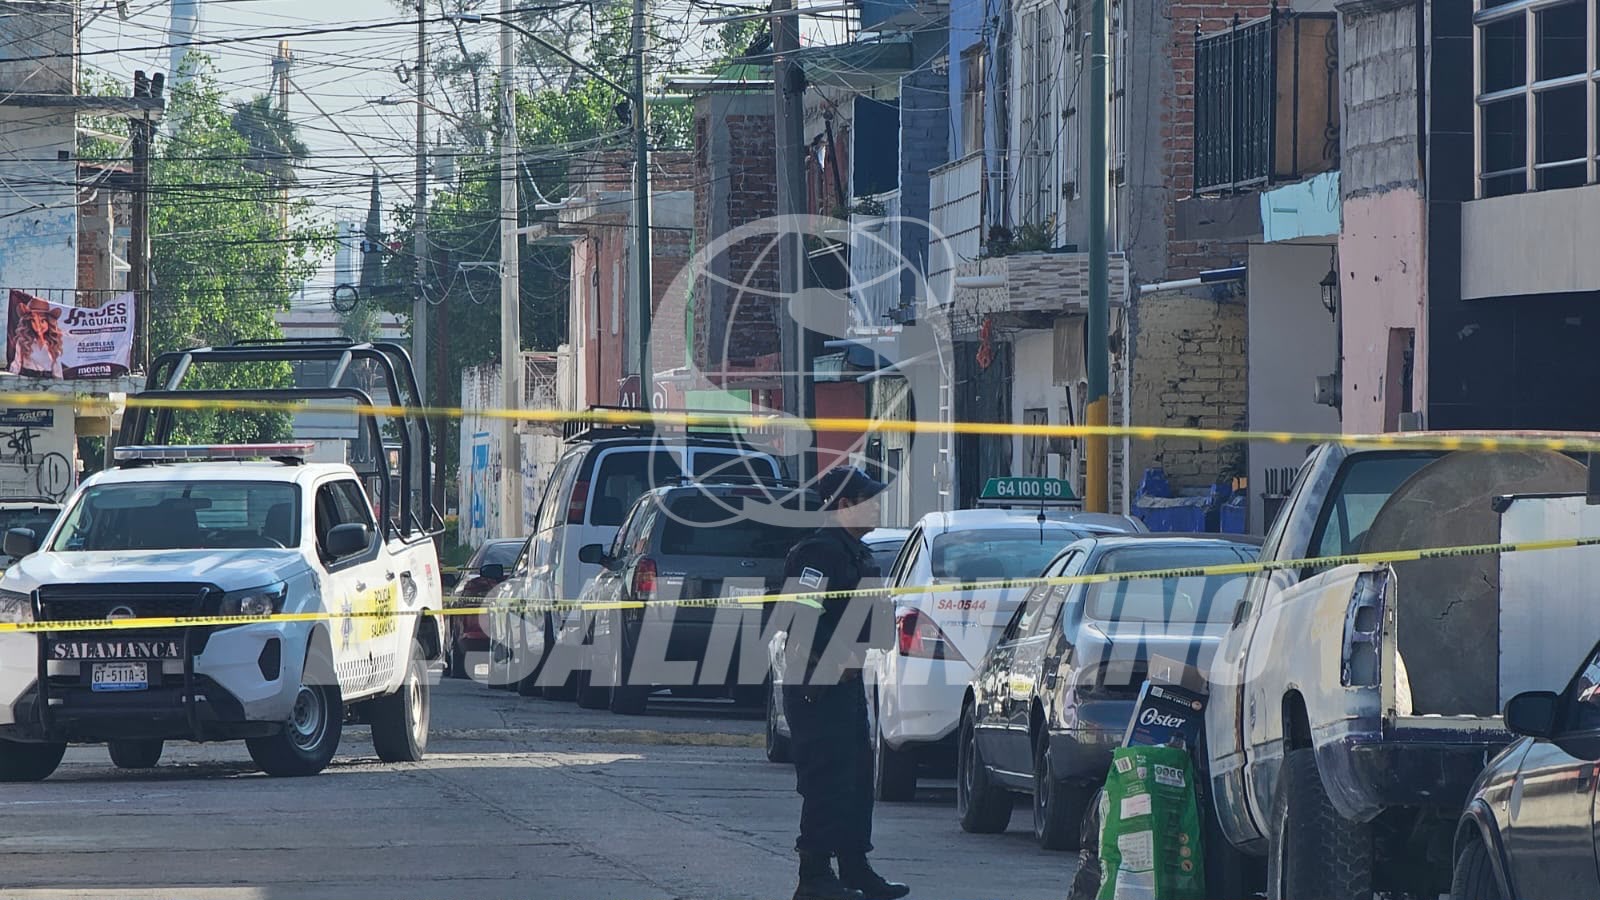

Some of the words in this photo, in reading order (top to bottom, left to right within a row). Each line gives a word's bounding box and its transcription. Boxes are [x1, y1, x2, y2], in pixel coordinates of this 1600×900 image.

[82, 315, 127, 327] AGUILAR
[78, 365, 111, 374] morena
[621, 391, 665, 409] ALO
[997, 481, 1014, 496] 64
[1019, 481, 1040, 496] 100
[1044, 482, 1061, 496] 90
[938, 600, 986, 610] SA-0544
[54, 642, 178, 659] SALAMANCA
[94, 670, 146, 682] GT-511A-3
[1140, 707, 1186, 728] Oster
